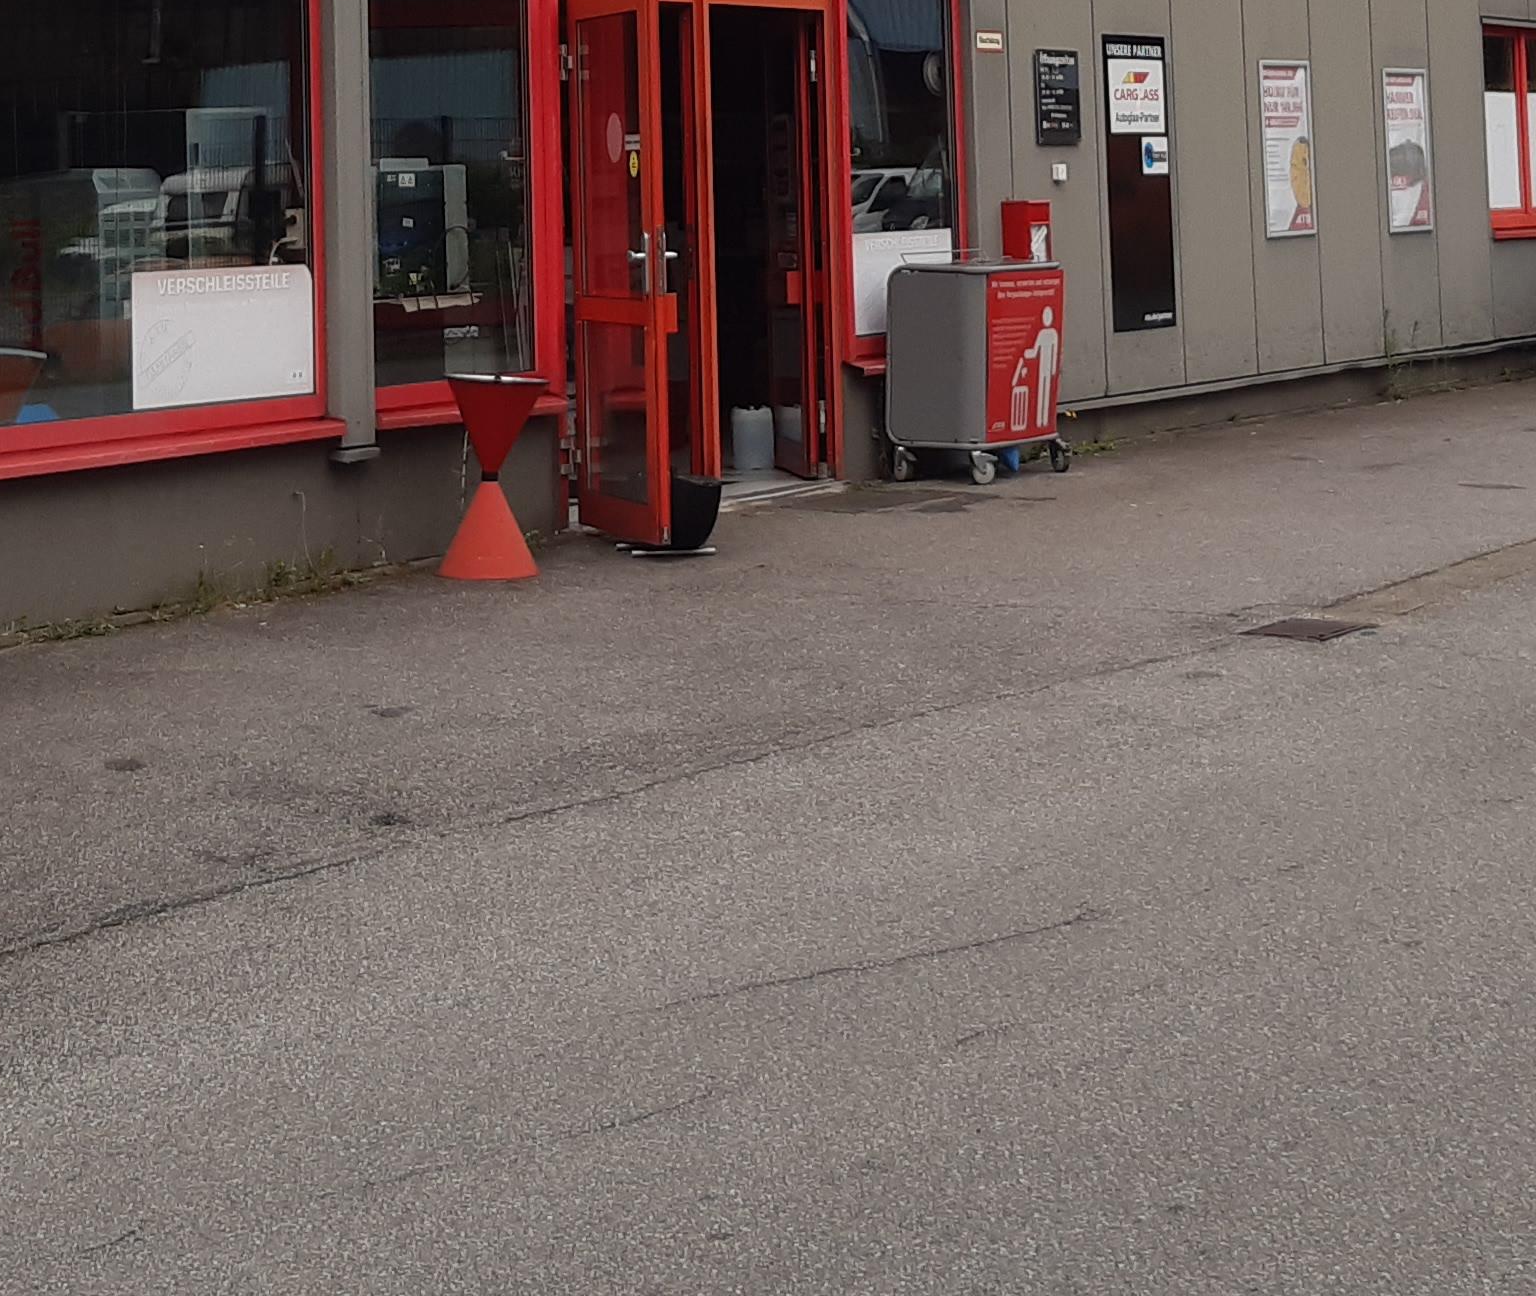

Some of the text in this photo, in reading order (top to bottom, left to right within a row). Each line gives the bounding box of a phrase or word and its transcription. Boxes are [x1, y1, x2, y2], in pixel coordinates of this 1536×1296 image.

[1106, 43, 1162, 57] UNSERE PARTNER
[157, 272, 290, 295] VERSCHLEISSTEILE
